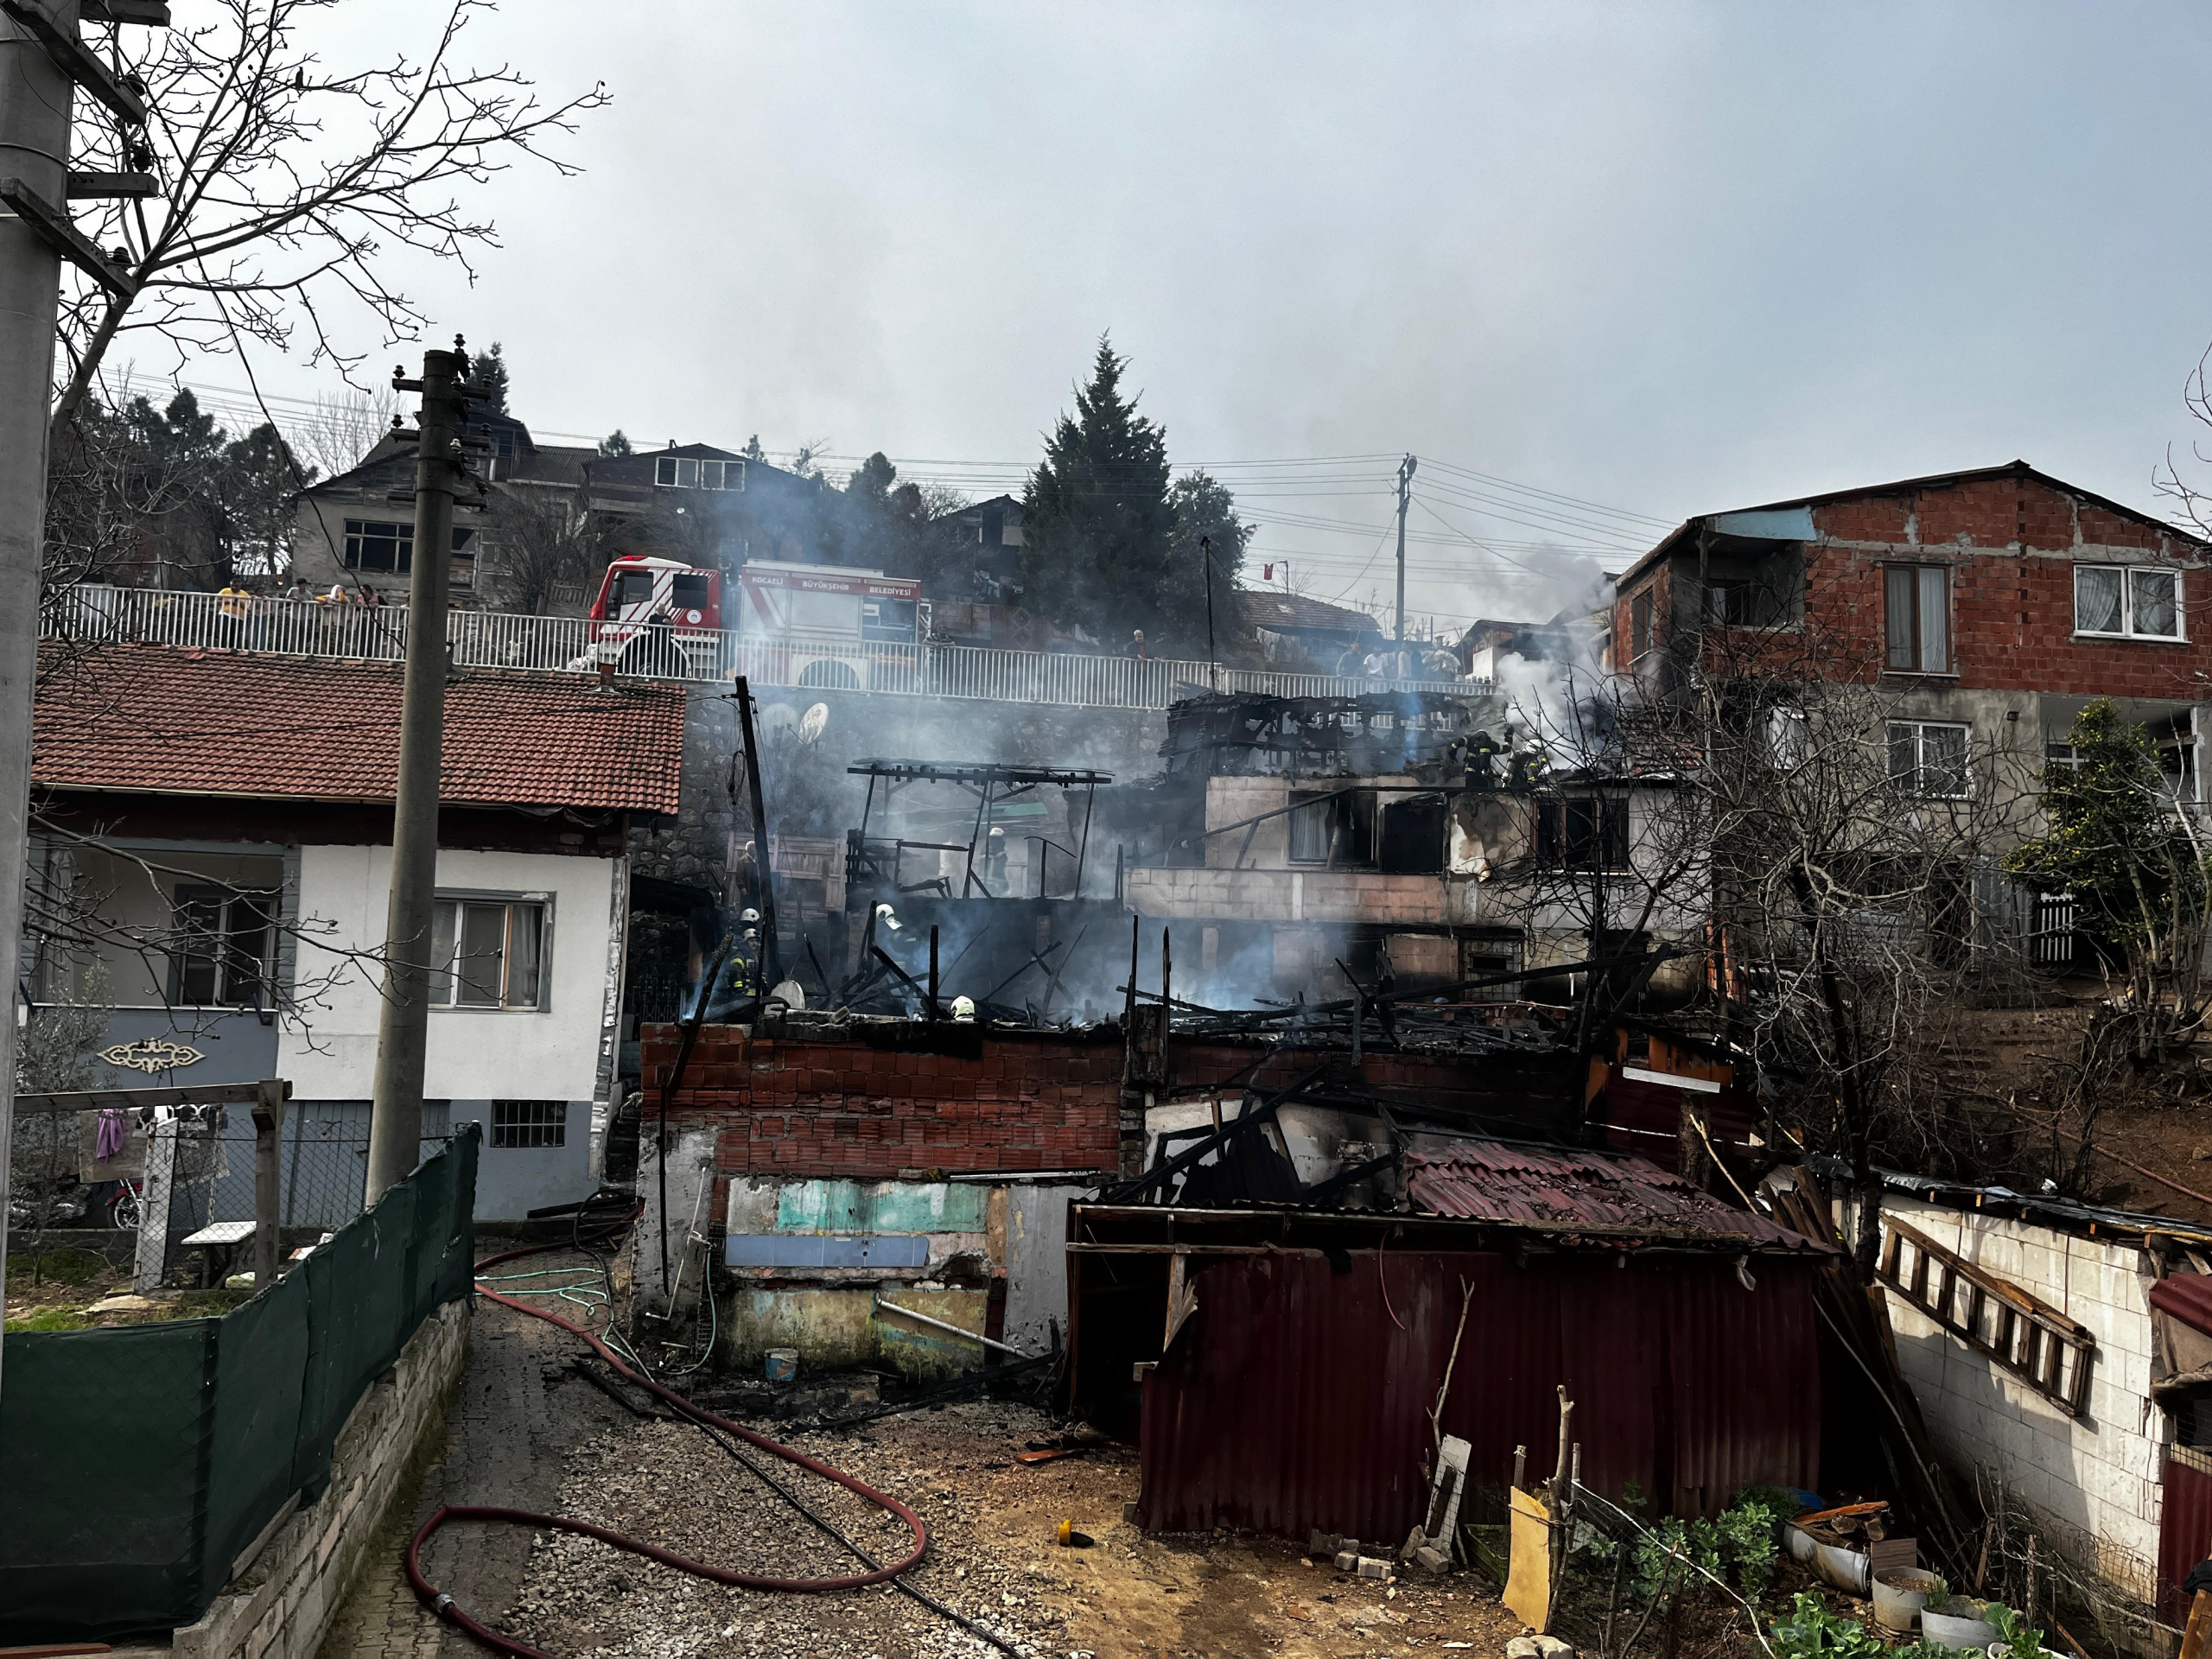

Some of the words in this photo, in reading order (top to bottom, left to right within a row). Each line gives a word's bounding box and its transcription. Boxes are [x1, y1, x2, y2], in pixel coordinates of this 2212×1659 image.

[752, 576, 784, 585] KOCAELİ
[802, 580, 849, 591] BÜYÜKŞEHİR
[869, 586, 912, 596] BELEDİYESİ
